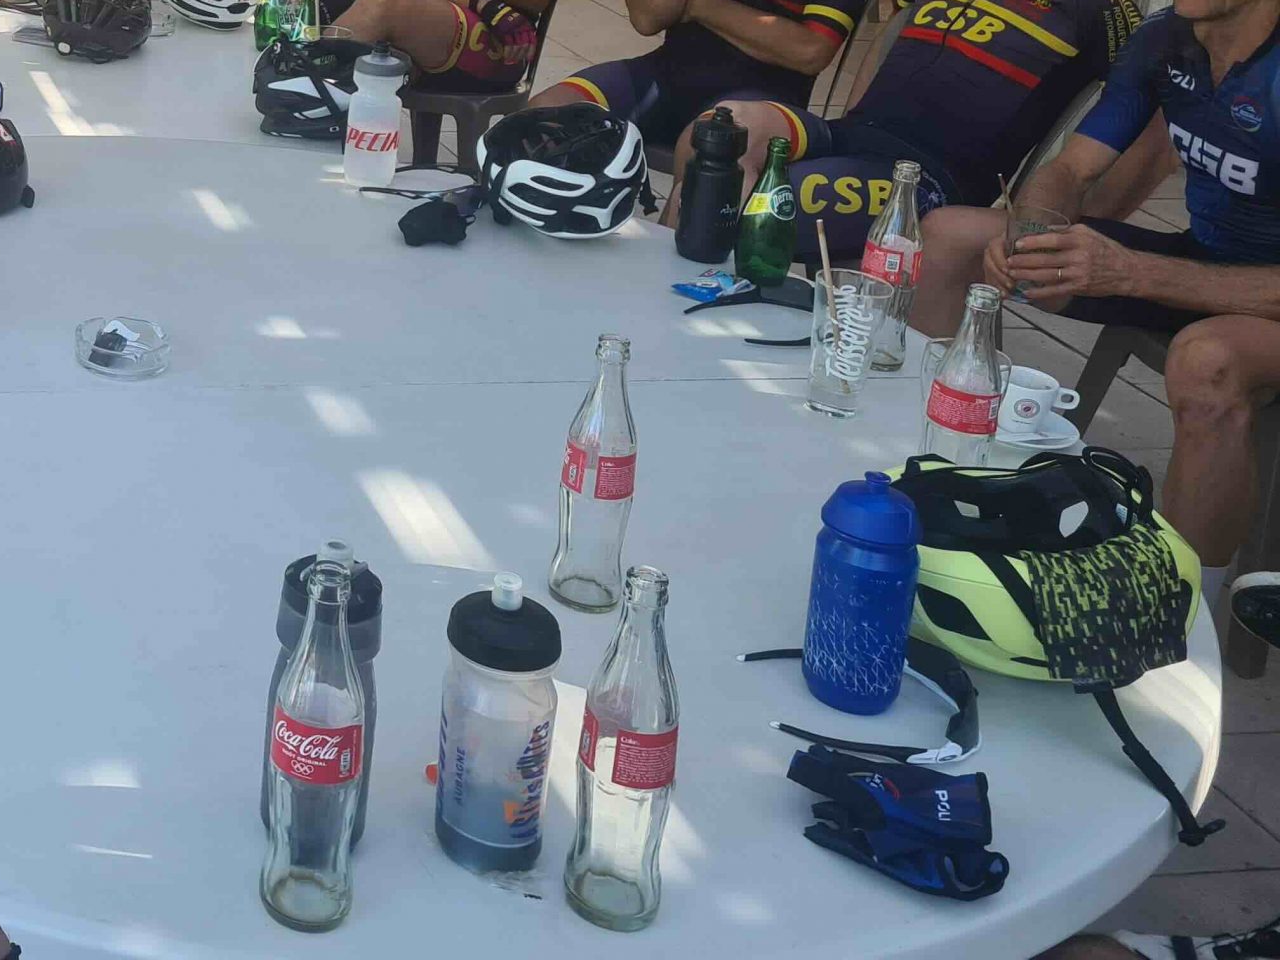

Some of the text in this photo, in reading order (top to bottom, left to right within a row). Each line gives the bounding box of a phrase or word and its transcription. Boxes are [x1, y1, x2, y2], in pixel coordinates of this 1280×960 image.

[913, 0, 1006, 43] CSB
[1169, 122, 1260, 196] CSB
[800, 173, 894, 216] CSB
[275, 720, 344, 760] Coca-Cola
[454, 746, 466, 806] AUBAGNE
[935, 789, 951, 821] POLI
